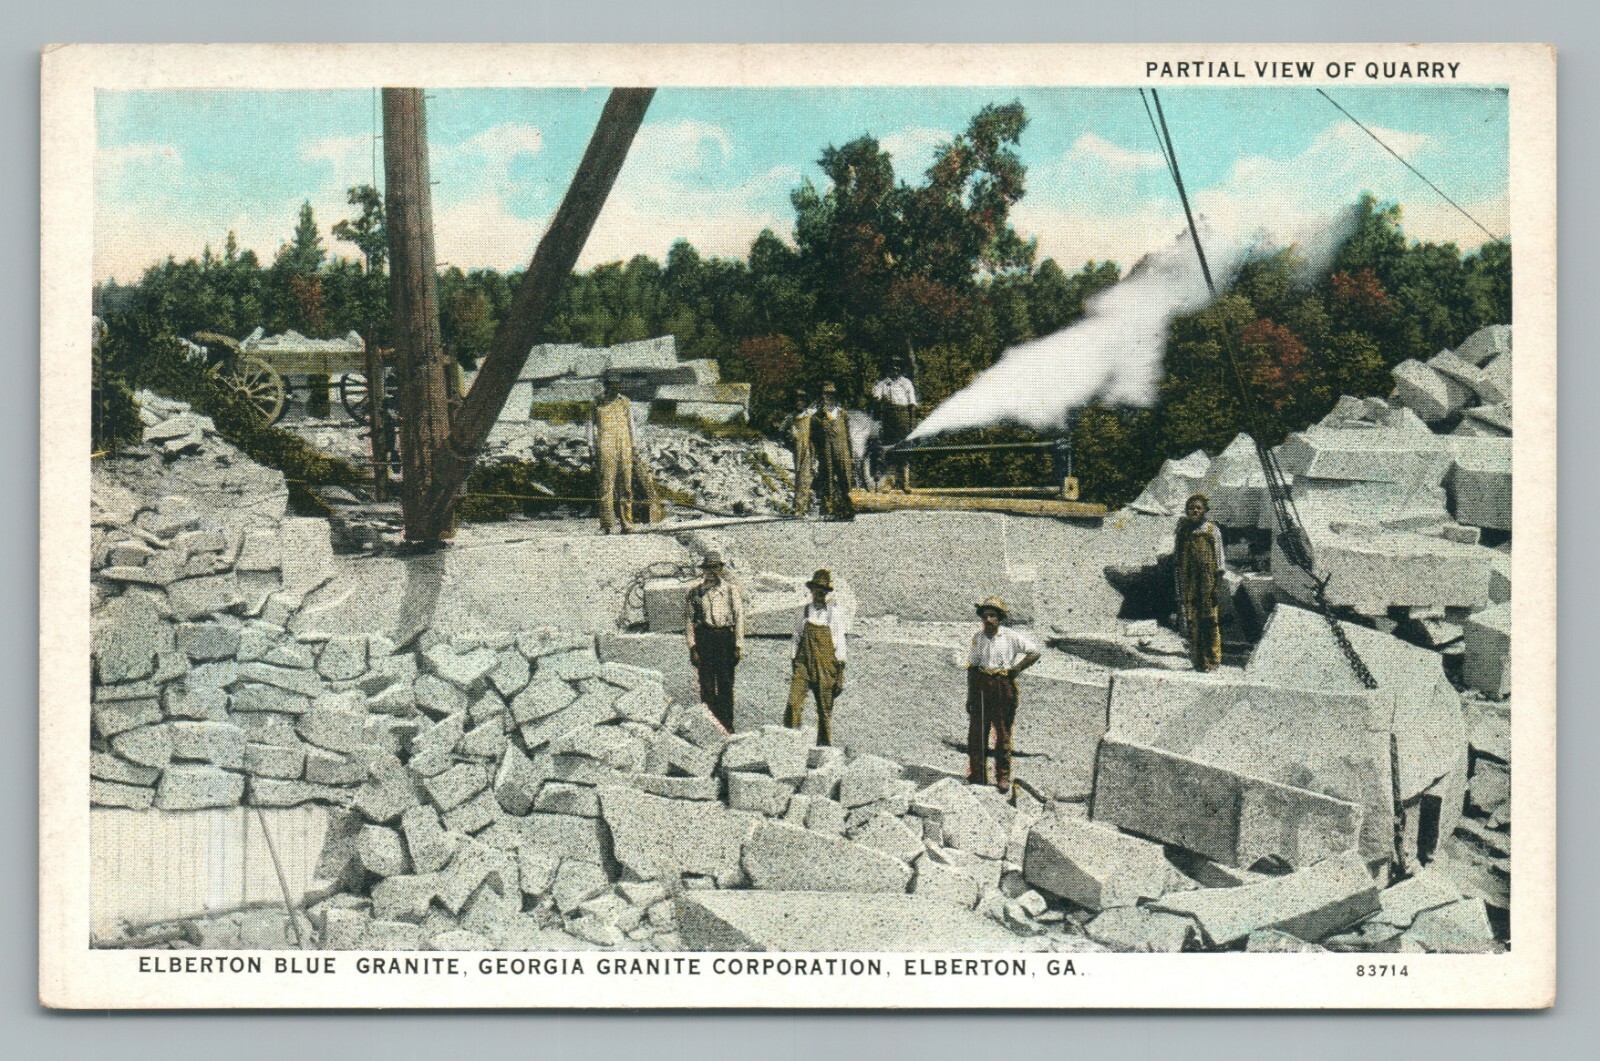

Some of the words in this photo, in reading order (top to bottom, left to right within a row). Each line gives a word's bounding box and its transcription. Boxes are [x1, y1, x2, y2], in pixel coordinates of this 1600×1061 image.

[1146, 61, 1246, 78] PARTIAL
[1254, 60, 1315, 78] VIEW
[1325, 61, 1356, 79] OF
[1365, 61, 1460, 80] QUARRY
[139, 956, 261, 973] ELBERTON
[275, 956, 336, 974] BLUE
[356, 957, 468, 978] GRANITE,
[478, 957, 584, 975] GEORGIA
[596, 958, 701, 975] GRANITE
[712, 958, 892, 979] CORPORATION,
[905, 958, 1037, 979] ELBERTON,
[1047, 959, 1087, 976] GA.
[1356, 964, 1409, 977] 83714
